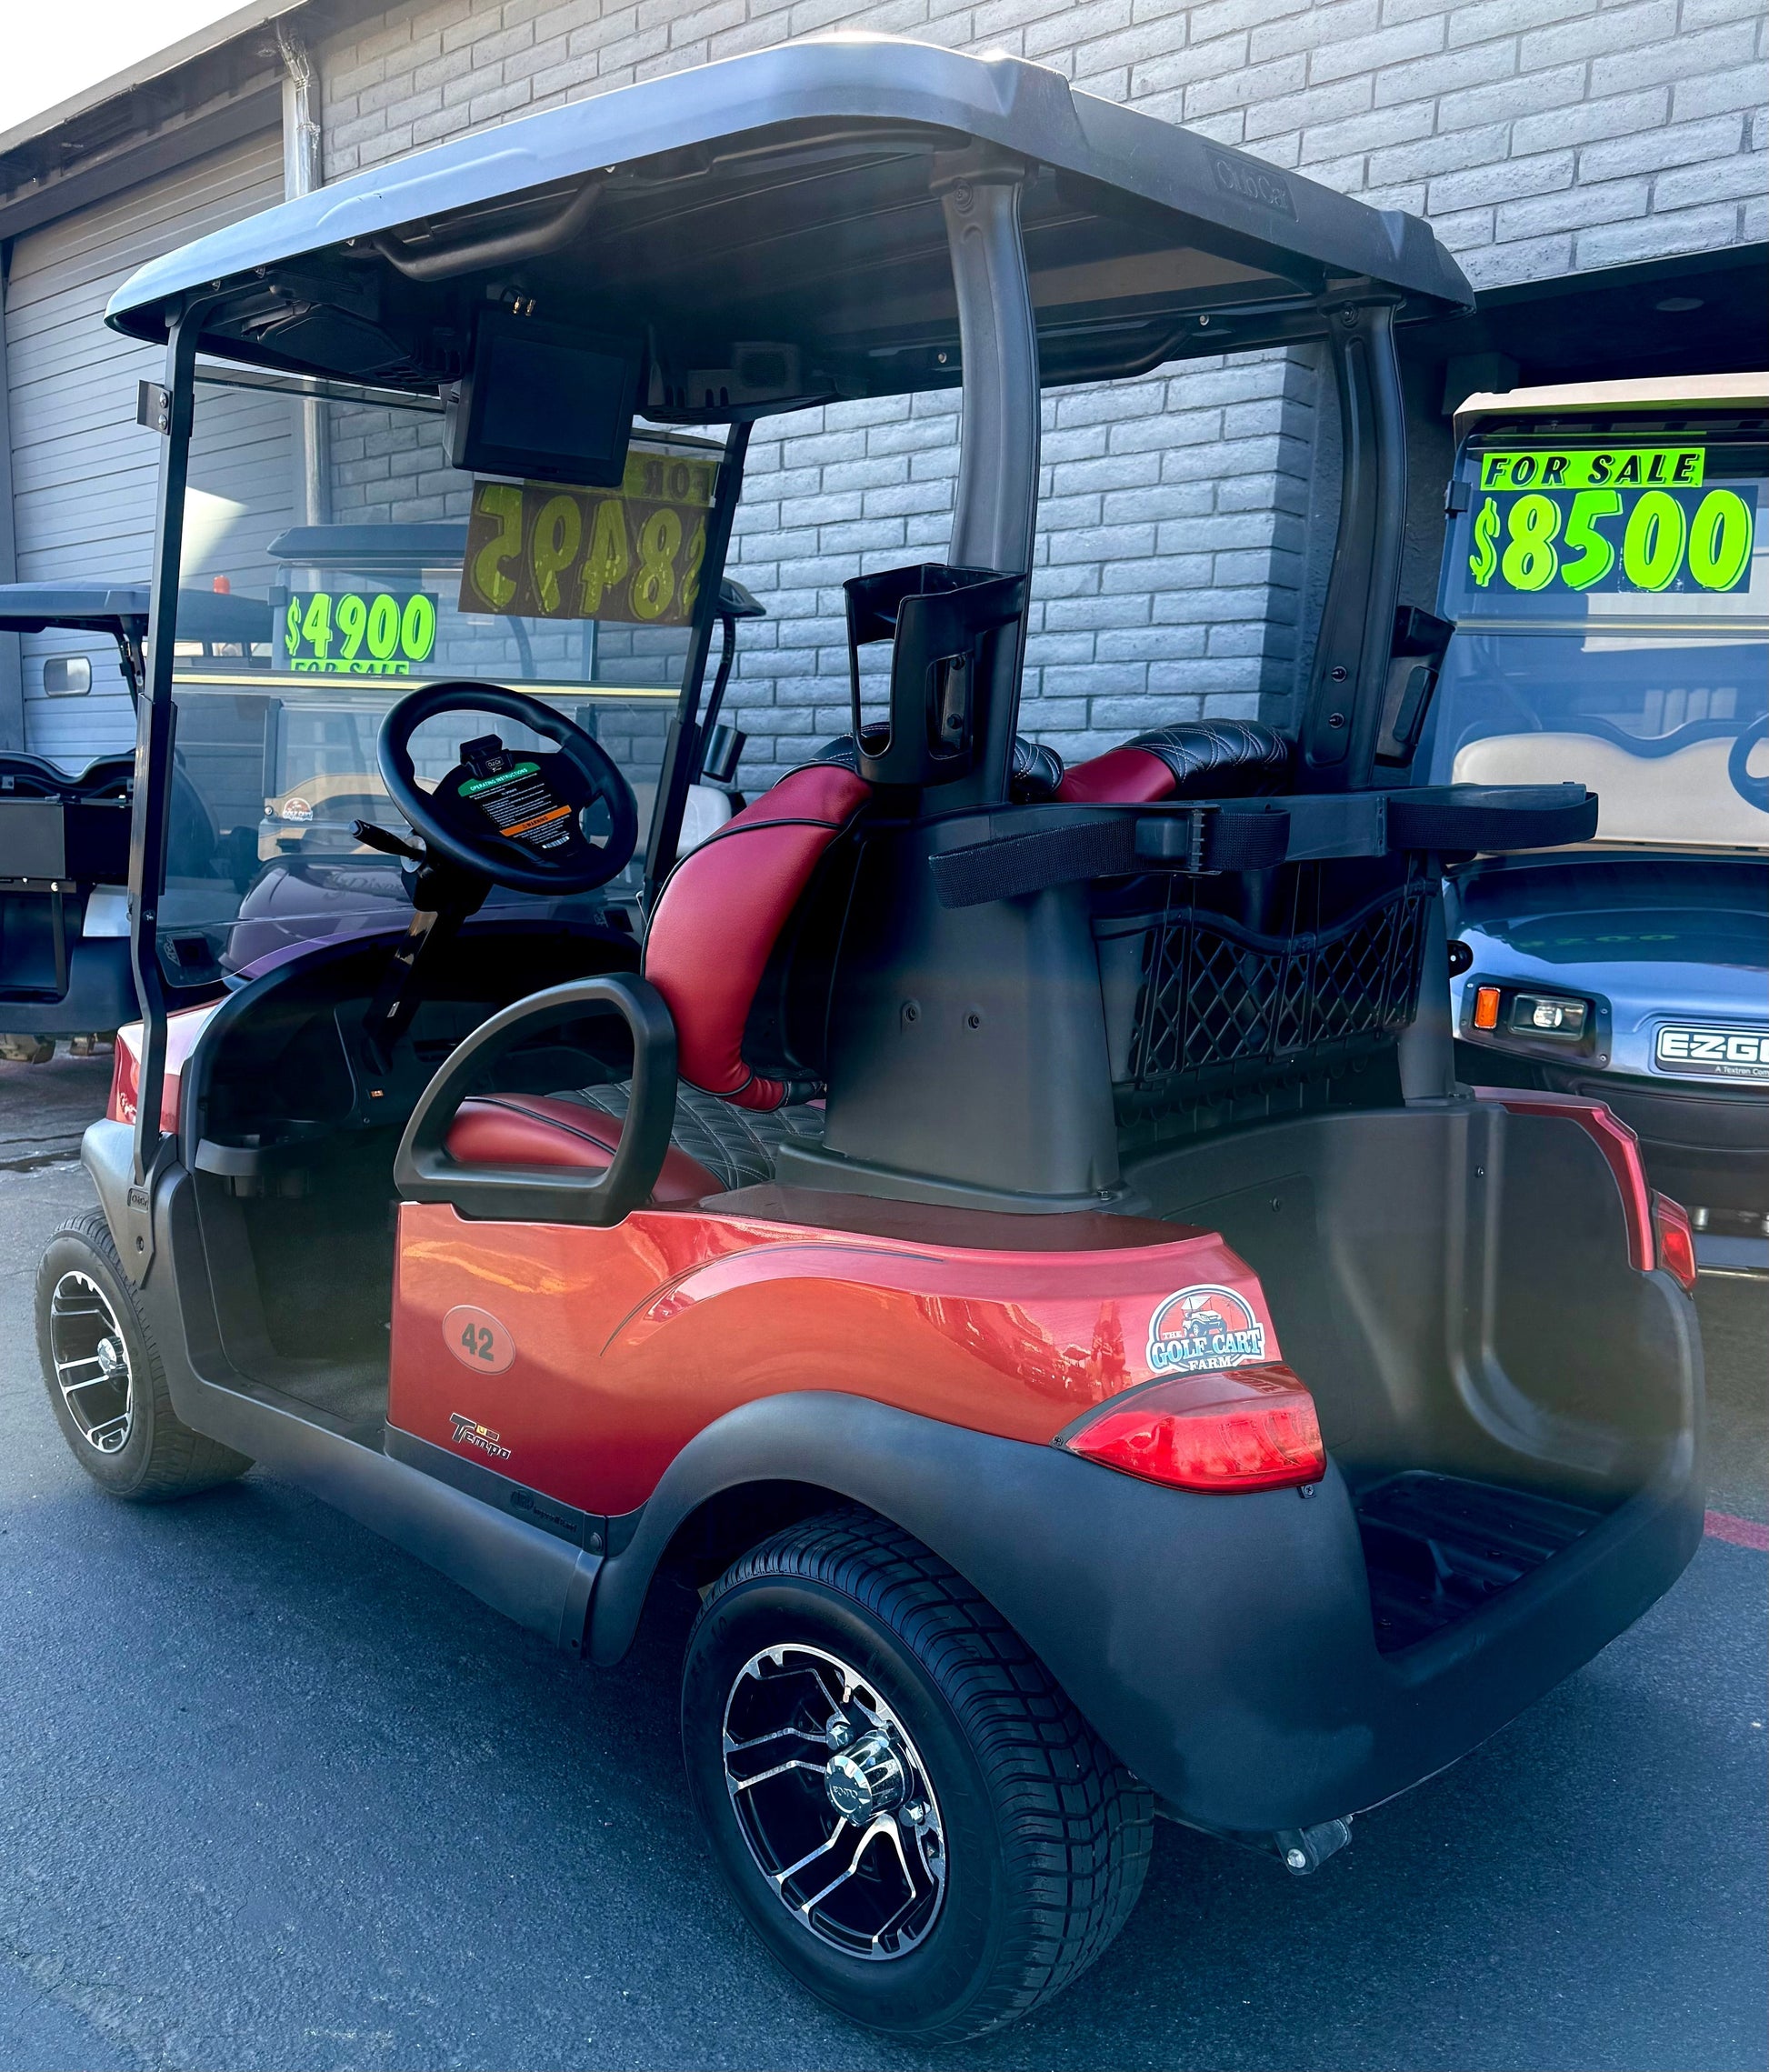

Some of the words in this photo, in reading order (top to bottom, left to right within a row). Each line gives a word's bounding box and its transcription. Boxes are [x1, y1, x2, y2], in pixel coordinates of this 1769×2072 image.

[1485, 455, 1571, 486] FOR
[1587, 453, 1699, 484] SALE
[1469, 489, 1754, 591] $8500
[285, 593, 436, 663] $4900
[1661, 1032, 1769, 1063] EZG
[1724, 1066, 1752, 1076] Textron
[460, 1323, 495, 1362] 42
[1152, 1337, 1207, 1368] GOLF
[1212, 1328, 1262, 1355] CART
[1188, 1355, 1234, 1371] FARM
[449, 1412, 512, 1460] Tempo
